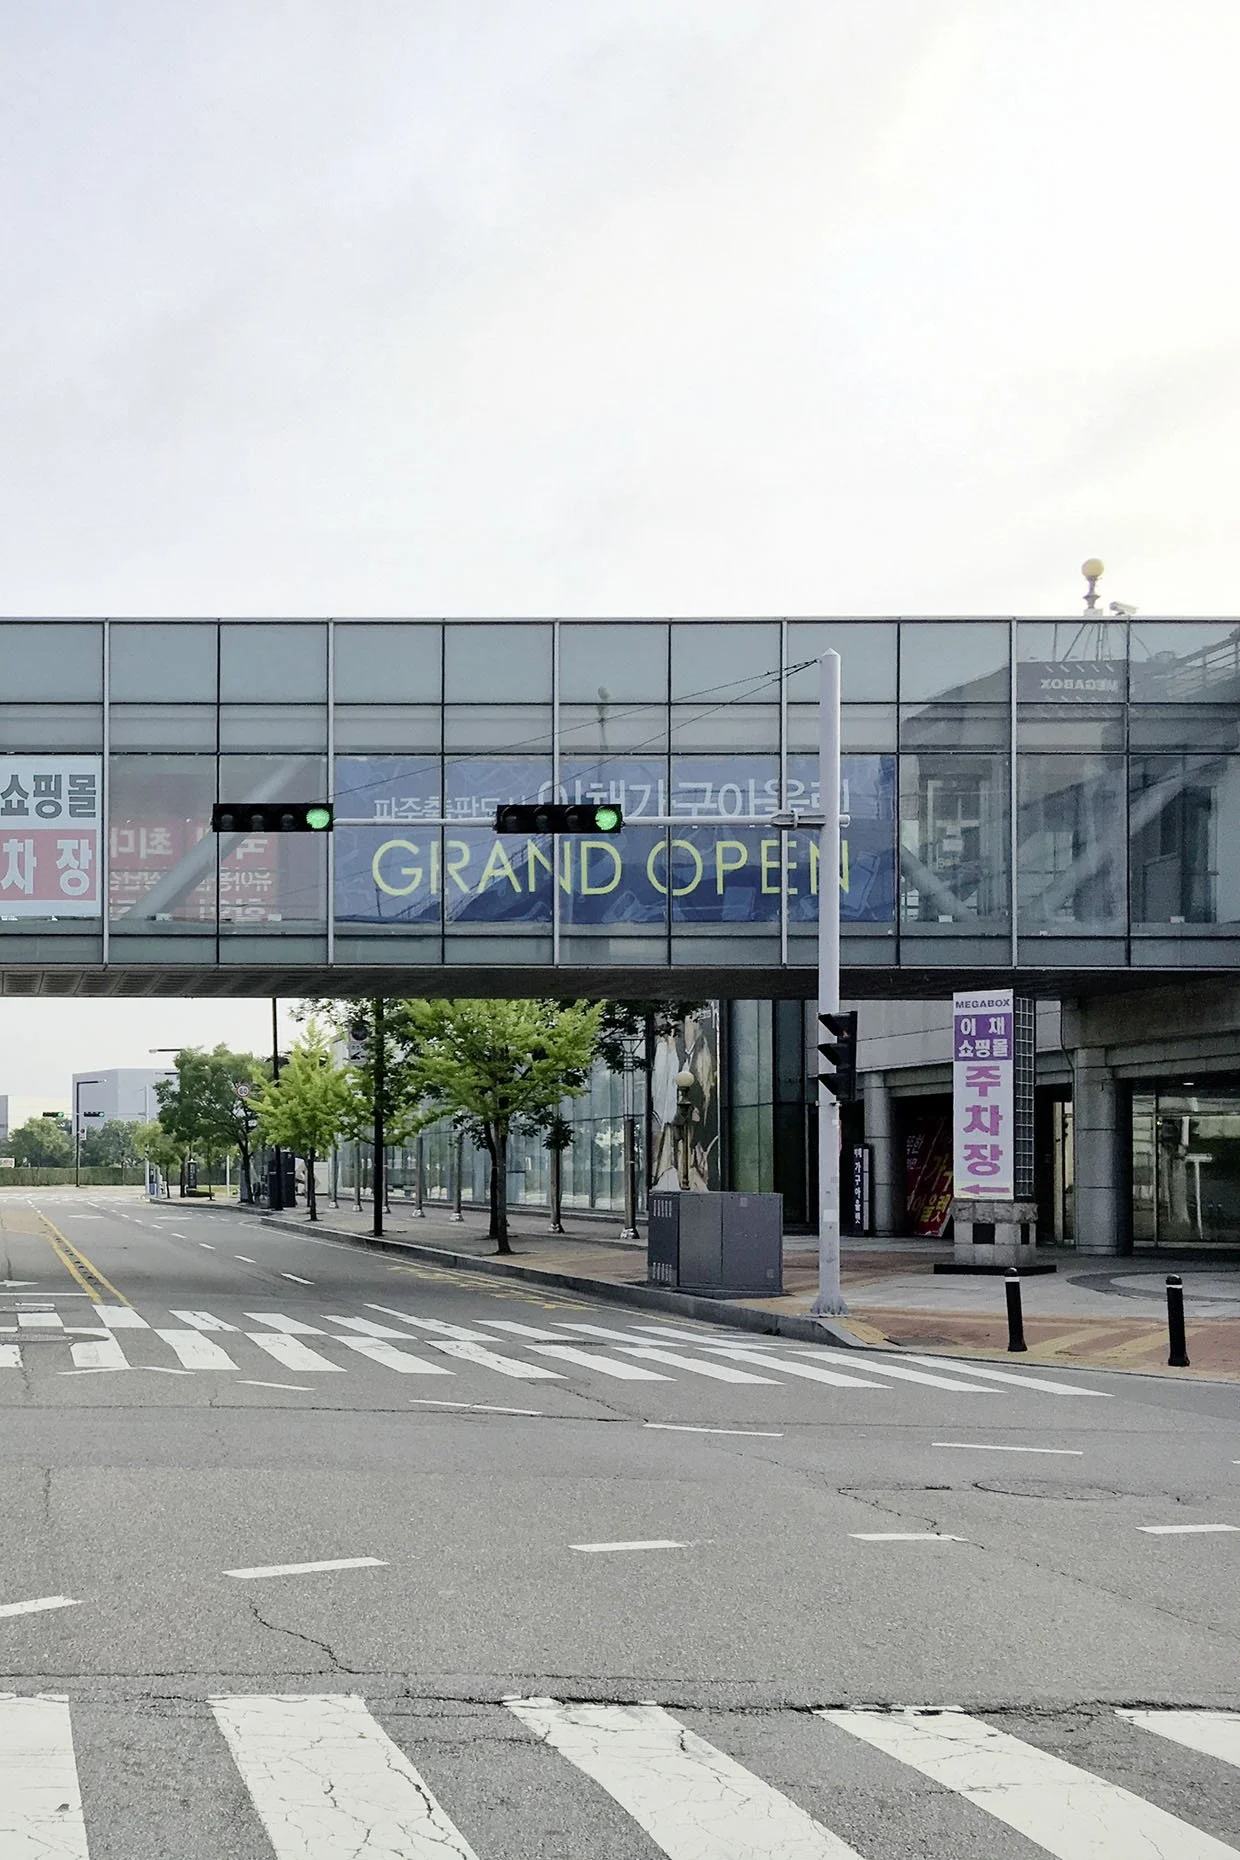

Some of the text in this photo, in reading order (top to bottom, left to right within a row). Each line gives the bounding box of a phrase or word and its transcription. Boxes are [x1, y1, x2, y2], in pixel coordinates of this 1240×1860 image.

[0, 773, 97, 819] 쇼핑몰
[372, 839, 850, 897] GRAND OPEN
[955, 998, 1011, 1009] MEGABOX
[958, 1039, 1009, 1058] 쇼핑몰
